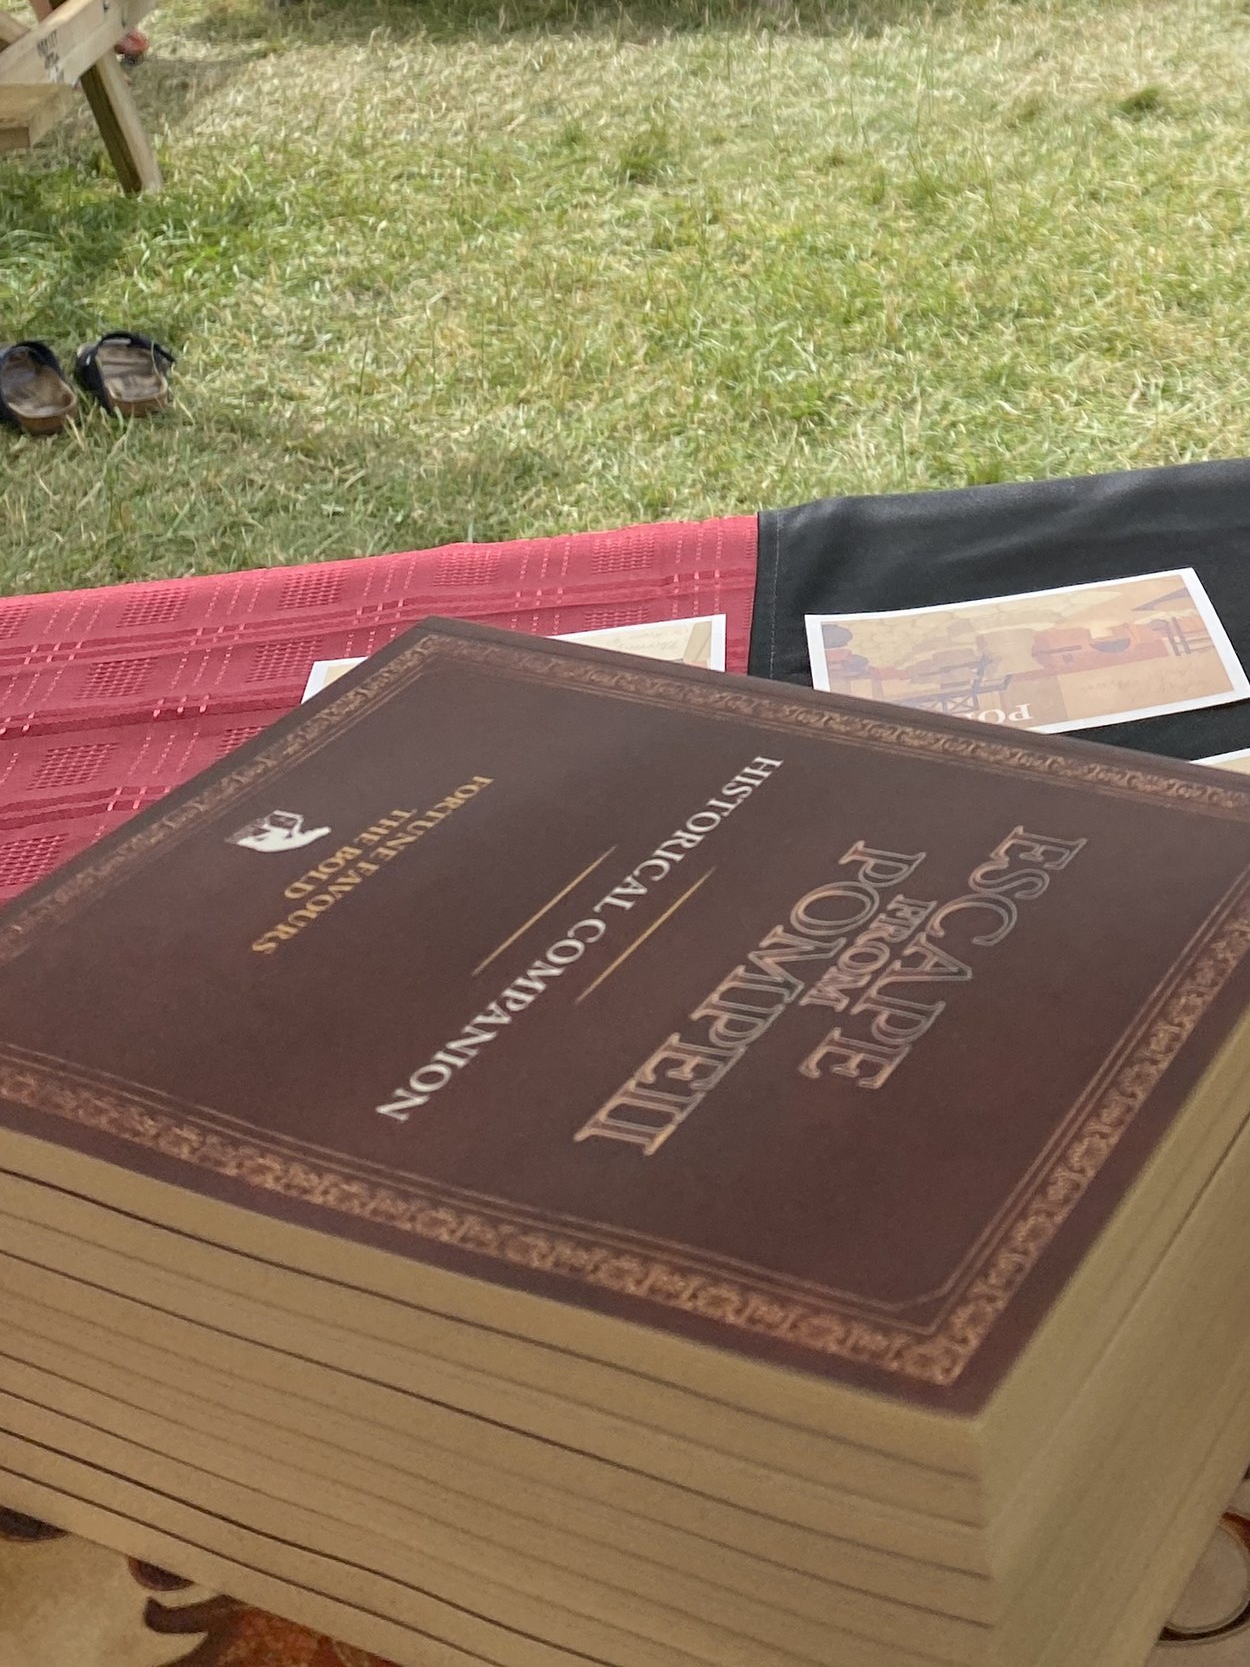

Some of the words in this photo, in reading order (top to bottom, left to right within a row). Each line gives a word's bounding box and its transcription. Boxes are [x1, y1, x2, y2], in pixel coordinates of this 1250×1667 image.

[284, 846, 363, 900] BOLD
[354, 808, 417, 846] THE
[370, 775, 494, 862] FORTUNE
[605, 756, 784, 911] HISTORICAL
[252, 861, 380, 954] FAVOURS
[798, 825, 1088, 1090] ESCAPE
[800, 893, 938, 1012] FROM
[376, 918, 607, 1123] COMPANION
[574, 840, 927, 1157] POMPEII
